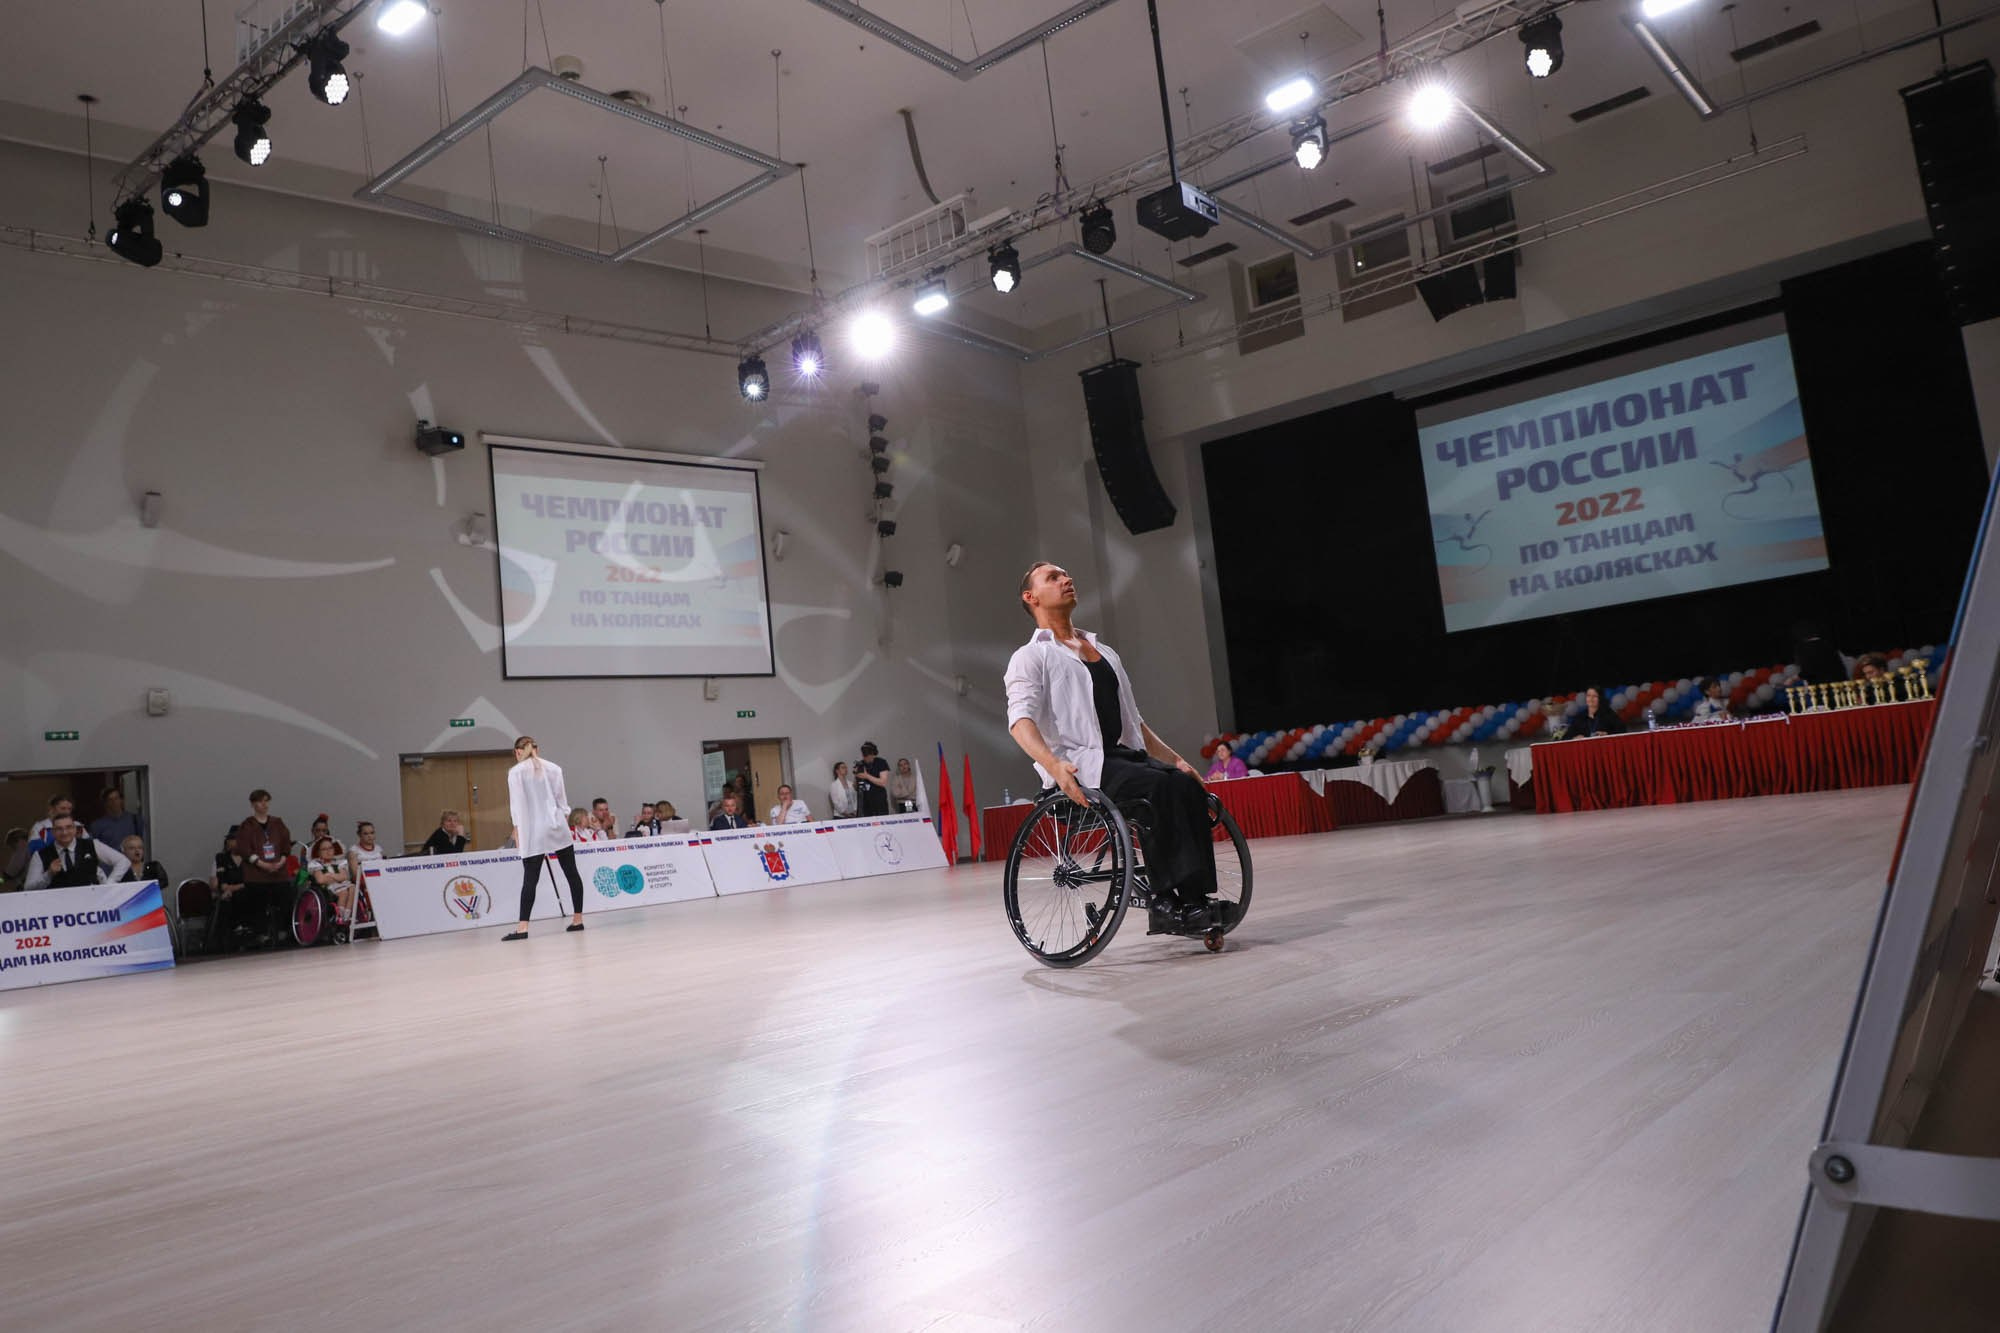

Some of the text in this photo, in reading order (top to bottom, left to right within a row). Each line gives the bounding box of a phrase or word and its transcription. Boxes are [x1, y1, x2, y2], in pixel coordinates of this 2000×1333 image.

[1436, 364, 1755, 467] ЧЕМПИОНАТ
[1496, 426, 1697, 500] РОССИИ
[520, 492, 727, 529] ЧЕМПИОНАТ
[1555, 488, 1644, 526] 2022
[565, 529, 695, 558] РОССИИ
[1519, 512, 1695, 565] ПО ТАНЦАМ
[605, 565, 663, 583] 2022
[1508, 542, 1718, 597] НА КОЛЯСКАХ
[579, 590, 691, 608] ПО ТАНЦАМ
[571, 613, 701, 628] НА КОЛЯСКАХ
[0, 908, 121, 934] ОНАТ РОССИИ
[15, 935, 51, 950] 2022
[30, 953, 51, 966] НА
[53, 944, 128, 963] КОЛЯСКАХ
